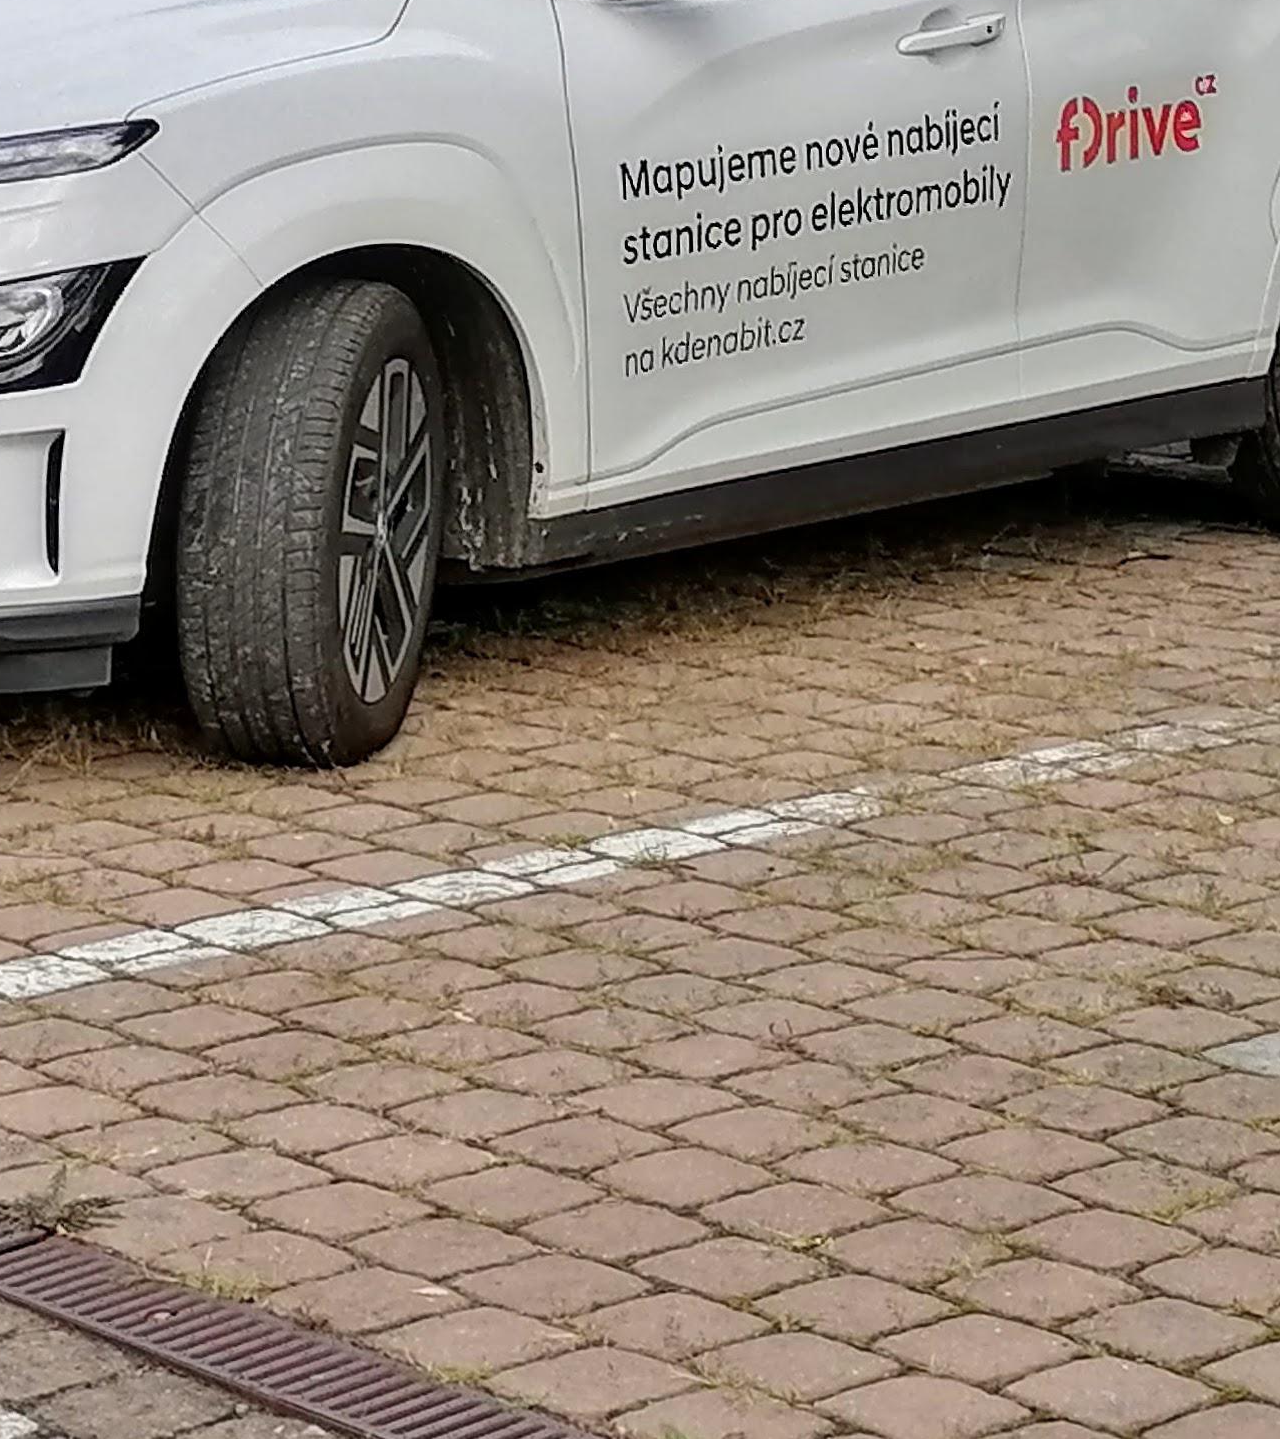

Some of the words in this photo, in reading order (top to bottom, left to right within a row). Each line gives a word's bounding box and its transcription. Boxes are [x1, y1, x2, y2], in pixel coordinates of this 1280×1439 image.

[620, 145, 797, 200] Mapujeme
[806, 121, 879, 170] nové
[887, 101, 1000, 156] nabíjecí
[623, 212, 742, 265] stanice
[751, 208, 802, 251] pro
[811, 164, 1011, 232] elektromobily
[623, 281, 731, 323] Všechny
[737, 254, 835, 303] nabíjecí
[840, 242, 925, 284] stanice
[626, 348, 654, 377] na
[662, 316, 806, 366] kdenabit.cz
